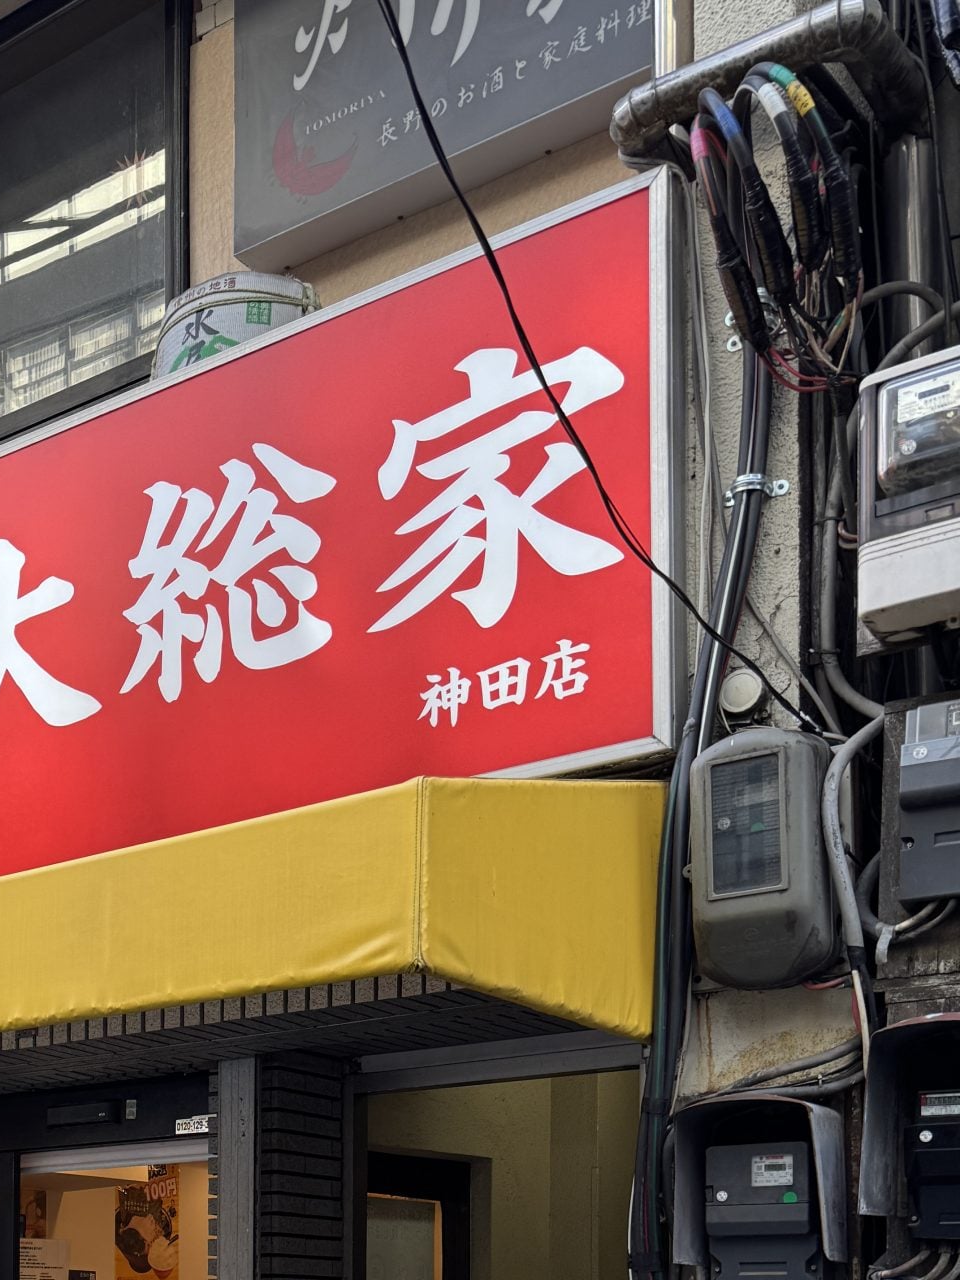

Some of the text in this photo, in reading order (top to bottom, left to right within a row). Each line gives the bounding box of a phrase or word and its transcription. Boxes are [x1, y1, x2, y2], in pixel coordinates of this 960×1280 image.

[304, 89, 387, 135] TOMORIYA
[376, 2, 652, 148] 長野のお酒と家庭料理
[416, 638, 591, 728] 神田店
